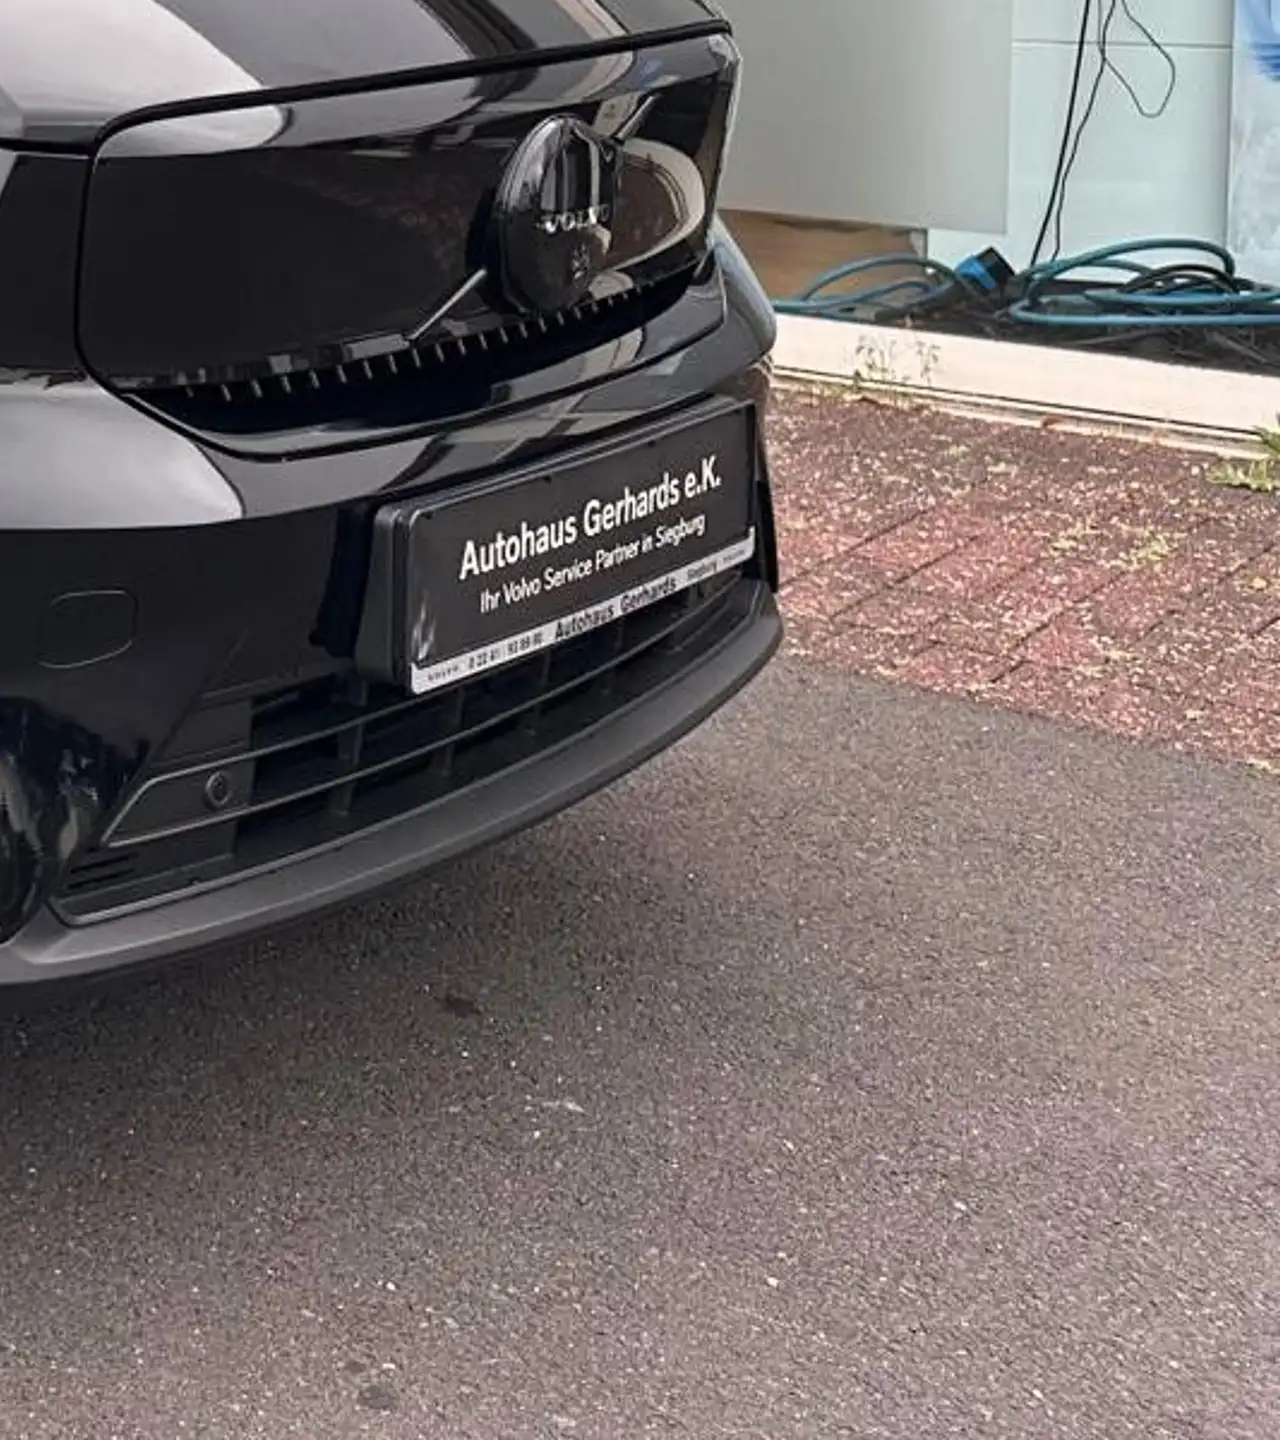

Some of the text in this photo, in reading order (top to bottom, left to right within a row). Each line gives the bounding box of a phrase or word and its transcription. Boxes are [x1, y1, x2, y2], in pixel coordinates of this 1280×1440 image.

[458, 454, 722, 581] Autohaus Gerhards e.K.
[479, 513, 706, 614] Ihr Volvo Service Partner in Siegburg
[555, 603, 615, 642] Autohaus
